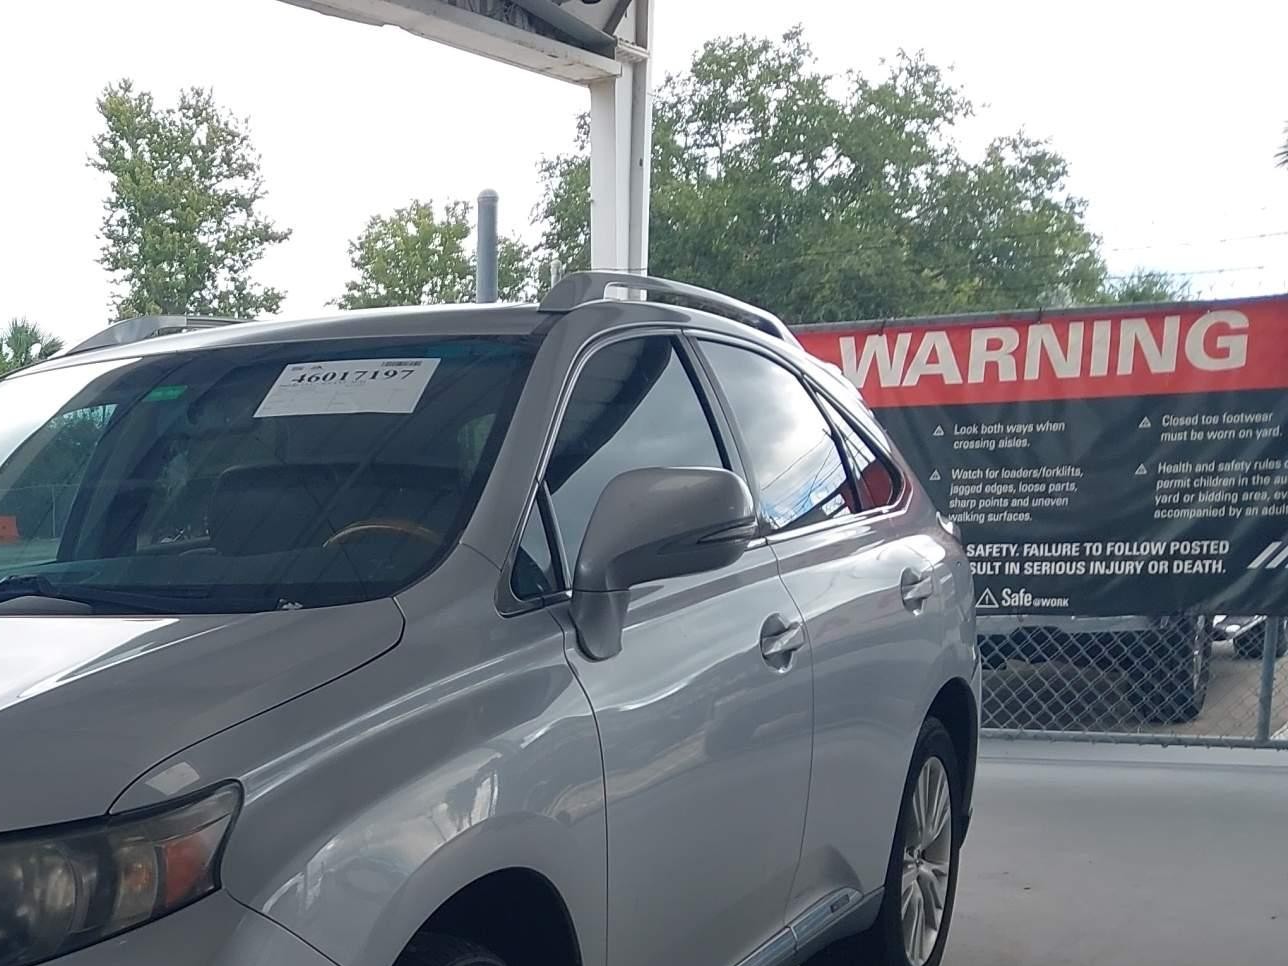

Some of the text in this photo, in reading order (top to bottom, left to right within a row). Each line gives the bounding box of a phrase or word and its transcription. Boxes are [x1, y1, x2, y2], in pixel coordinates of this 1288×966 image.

[838, 309, 1250, 388] WARNING
[291, 369, 416, 383] 46017197
[1162, 411, 1273, 427] Closed toe footwear
[954, 420, 1065, 435] Look both ways when
[1161, 425, 1283, 442] must be worn on yard.
[953, 437, 1030, 451] crossing aisles.
[951, 465, 1084, 480] Watch for loaders/forklifts,
[1158, 461, 1192, 474] Health
[1195, 461, 1215, 472] and
[1218, 460, 1251, 473] safety
[1253, 458, 1281, 470] rules
[950, 481, 1078, 496] jagged edges, loose parts,
[1156, 474, 1288, 490] permit children in the au
[949, 496, 1069, 509] sharp points and uneven
[1154, 489, 1288, 506] yard or bidding area, ev
[948, 510, 1032, 524] walking surfaces.
[1154, 505, 1226, 521] accompanied
[1229, 504, 1243, 519] by
[1245, 505, 1258, 516] an
[966, 540, 1230, 557] SAFETY. FAILURE TO FOLLOW POSTED
[970, 559, 1226, 575] SULT IN SERIOUS INJURY OR DEATH.
